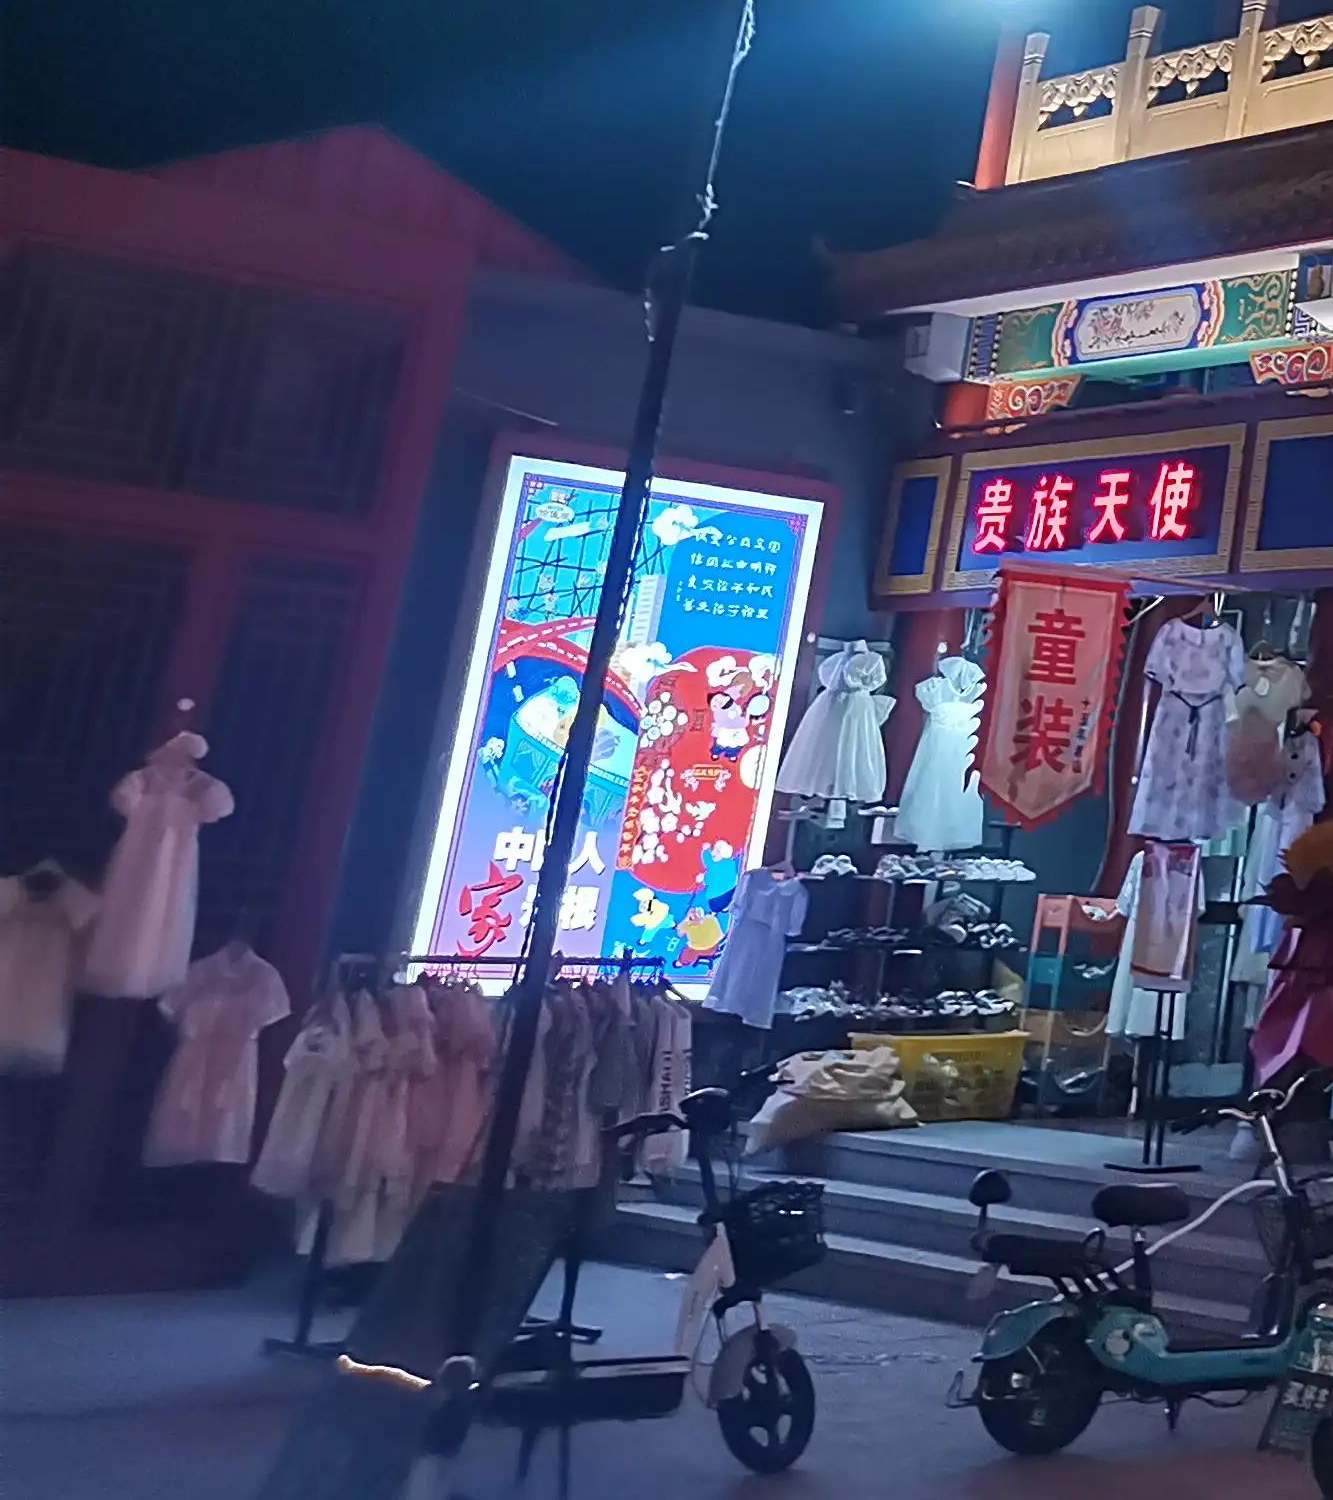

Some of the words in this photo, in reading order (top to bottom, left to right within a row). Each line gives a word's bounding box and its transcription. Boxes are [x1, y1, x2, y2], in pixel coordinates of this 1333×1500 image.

[974, 462, 1194, 553] 贵族天使
[1009, 608, 1086, 773] 童装
[494, 826, 606, 876] 中人
